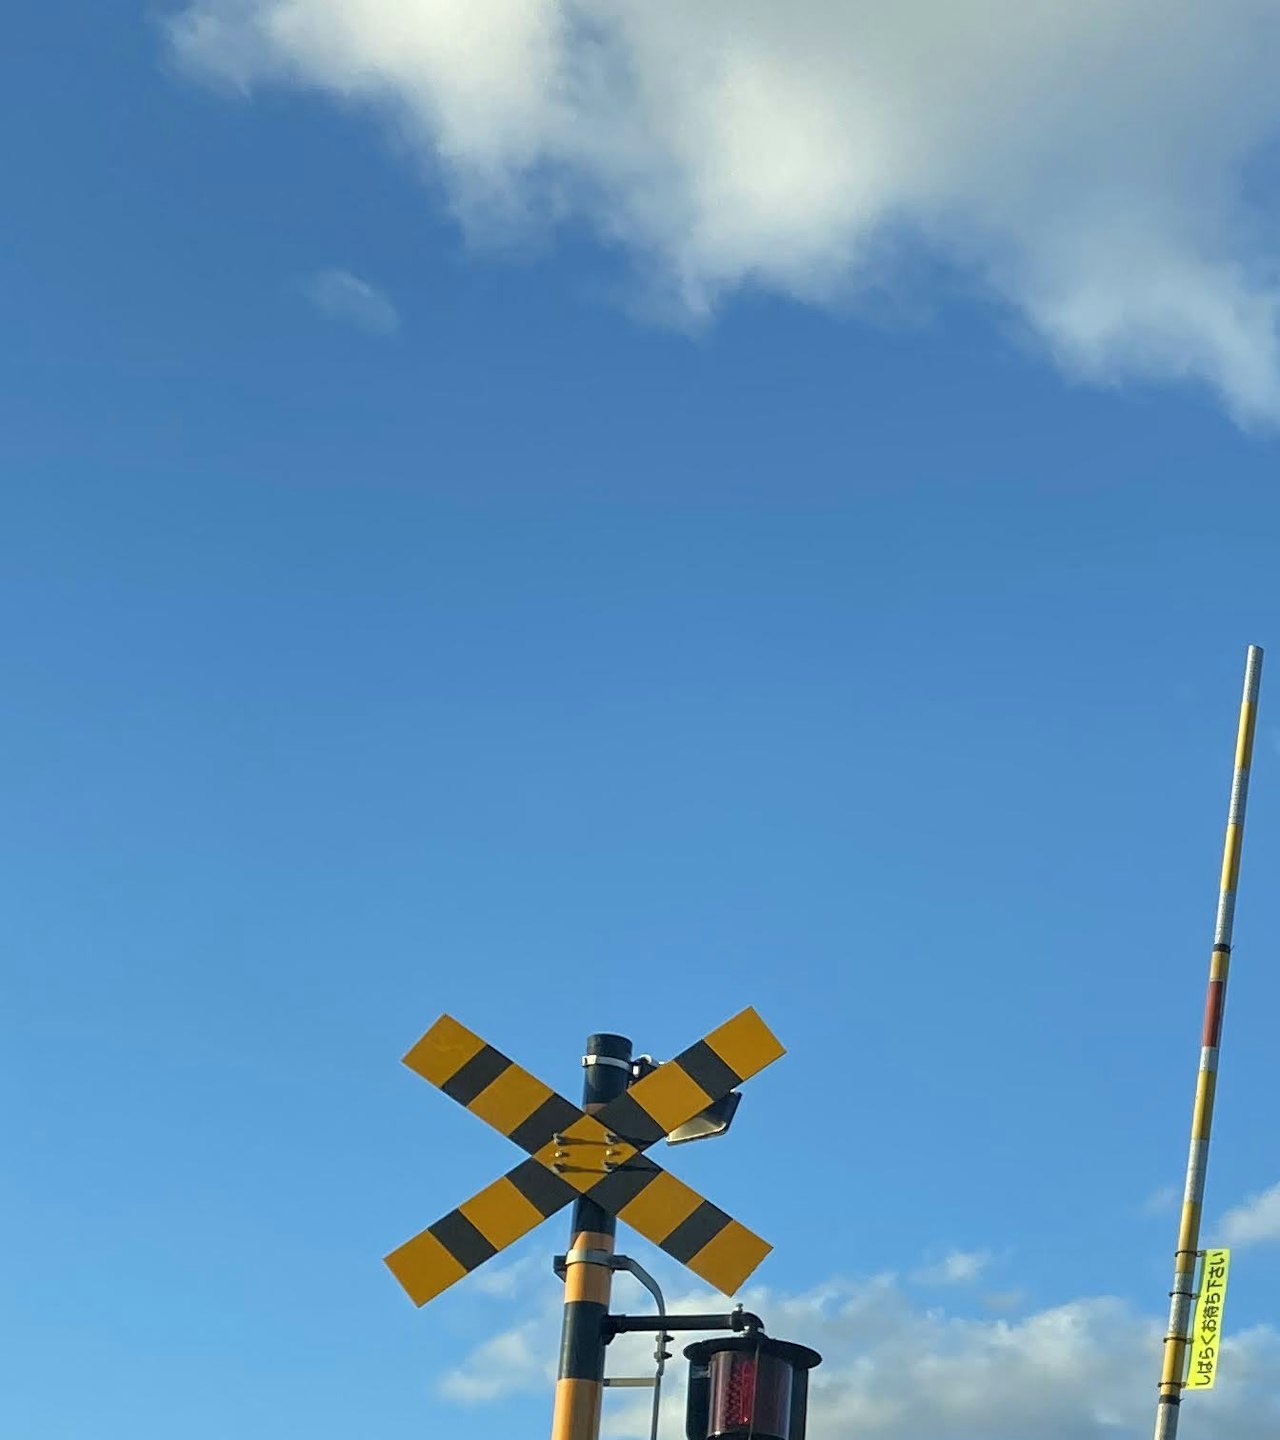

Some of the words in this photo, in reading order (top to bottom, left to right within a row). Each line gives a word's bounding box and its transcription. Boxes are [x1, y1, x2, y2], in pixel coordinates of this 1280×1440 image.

[1195, 1251, 1226, 1387] しばらくお待ち下さい
